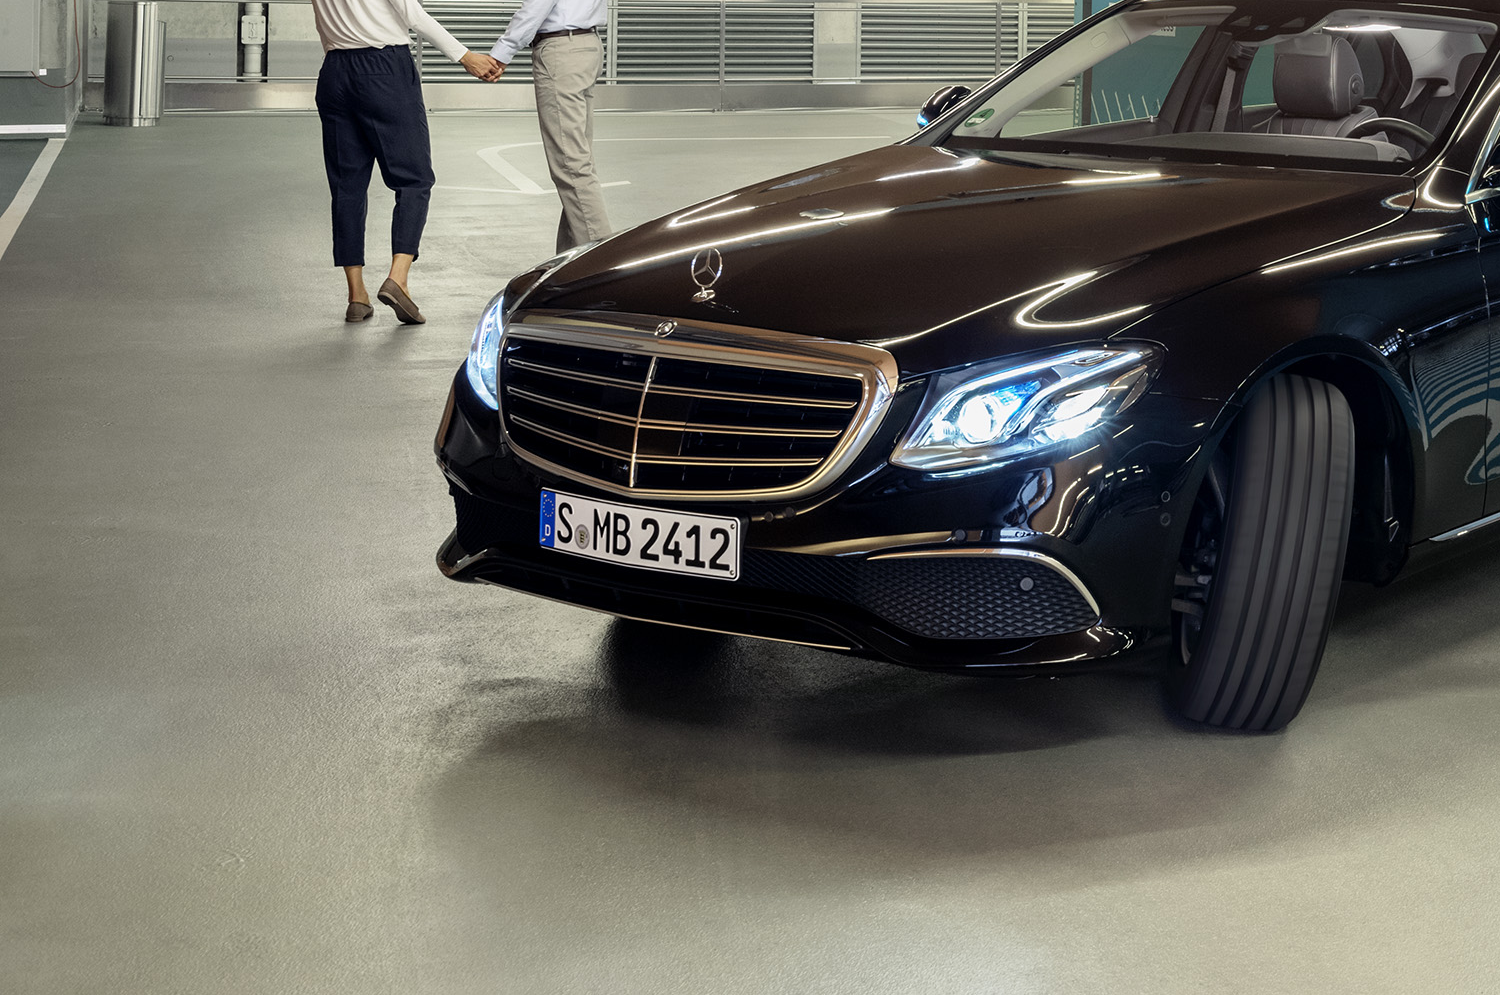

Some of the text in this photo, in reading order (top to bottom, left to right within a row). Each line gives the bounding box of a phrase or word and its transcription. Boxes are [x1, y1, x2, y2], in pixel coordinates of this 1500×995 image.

[544, 524, 551, 537] D
[557, 502, 731, 572] S MB 2412
